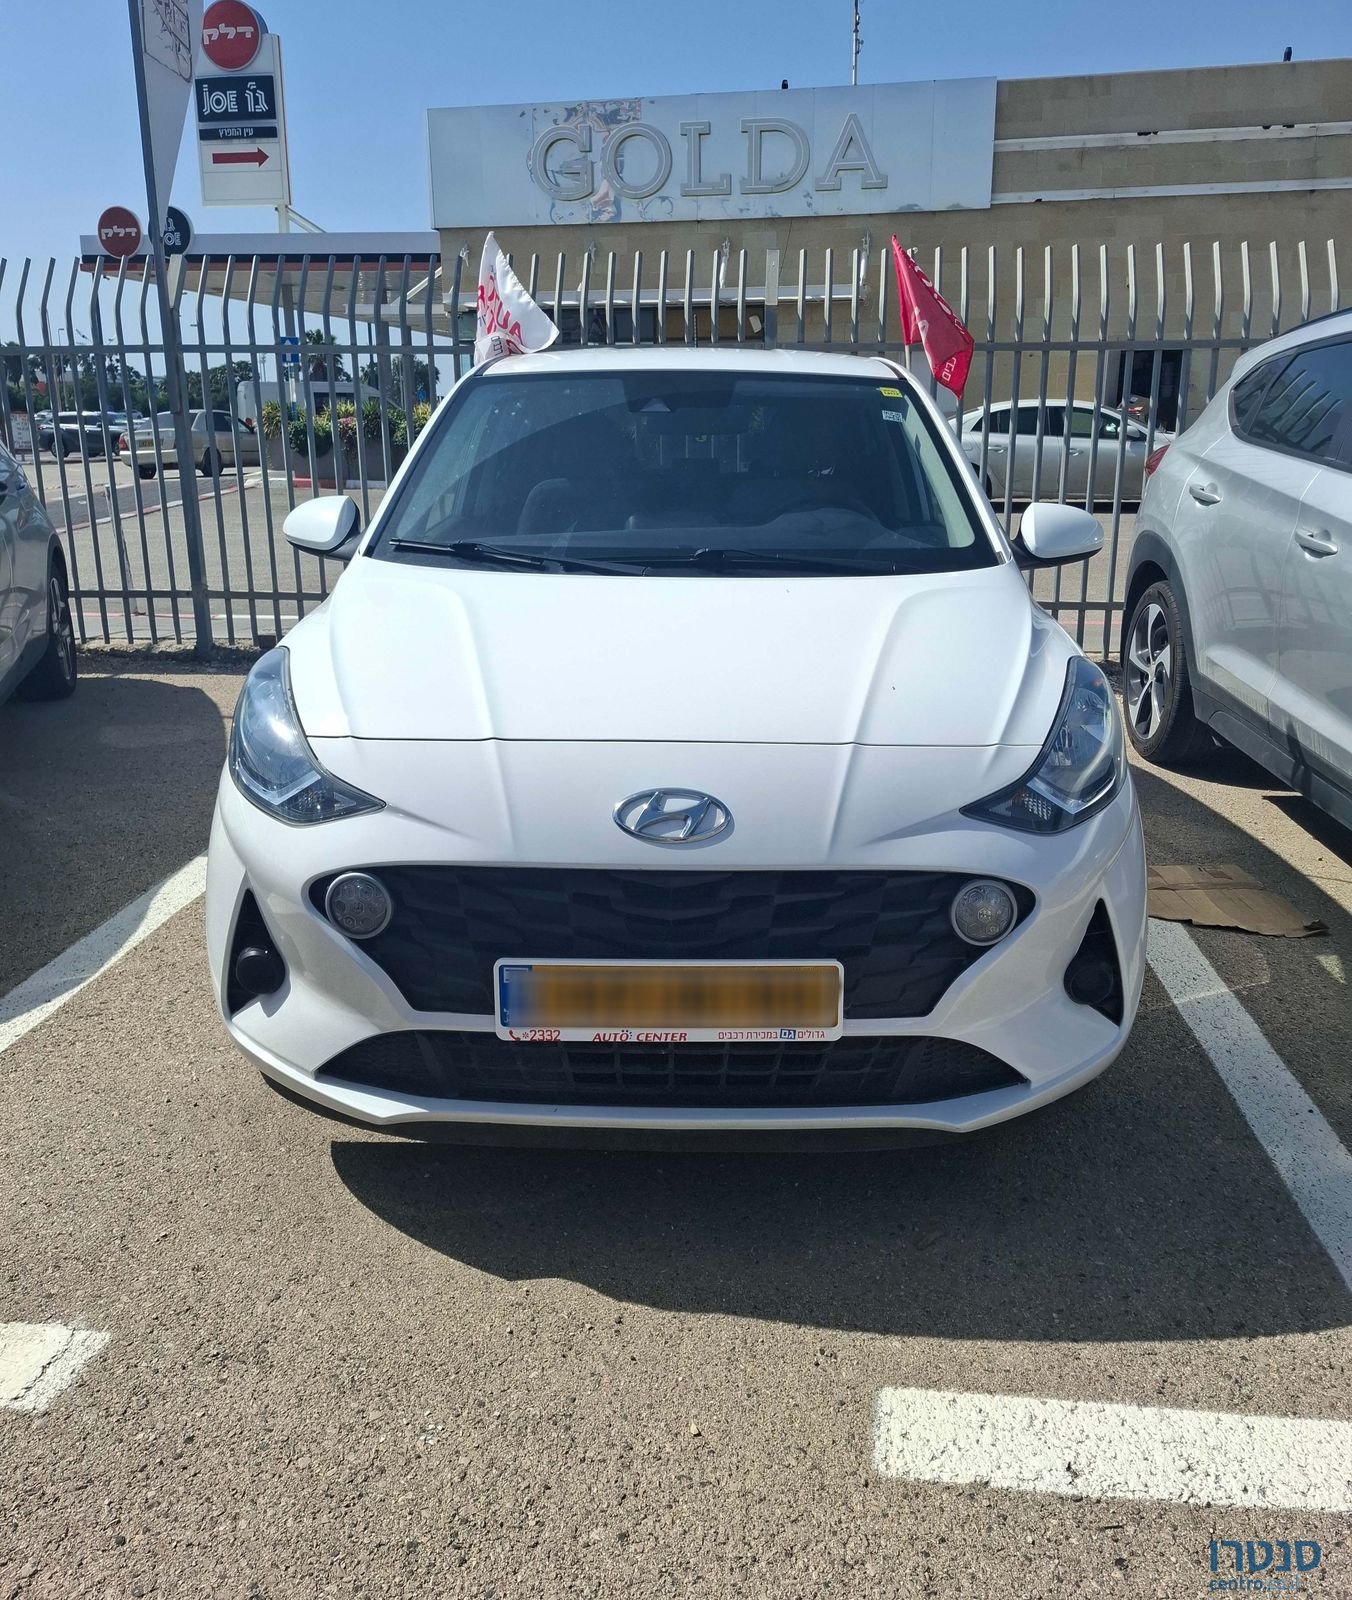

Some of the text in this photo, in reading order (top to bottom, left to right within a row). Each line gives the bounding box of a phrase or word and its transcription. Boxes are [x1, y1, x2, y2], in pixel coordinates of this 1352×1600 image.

[203, 23, 254, 45] דלק
[218, 127, 254, 138] עין המפרץ
[531, 112, 888, 201] GOLDA
[100, 225, 138, 240] דלק
[163, 231, 182, 246] OE
[593, 1030, 688, 1042] AUTO CENTER
[718, 1028, 826, 1040] גדולים גם במכירת רכבים
